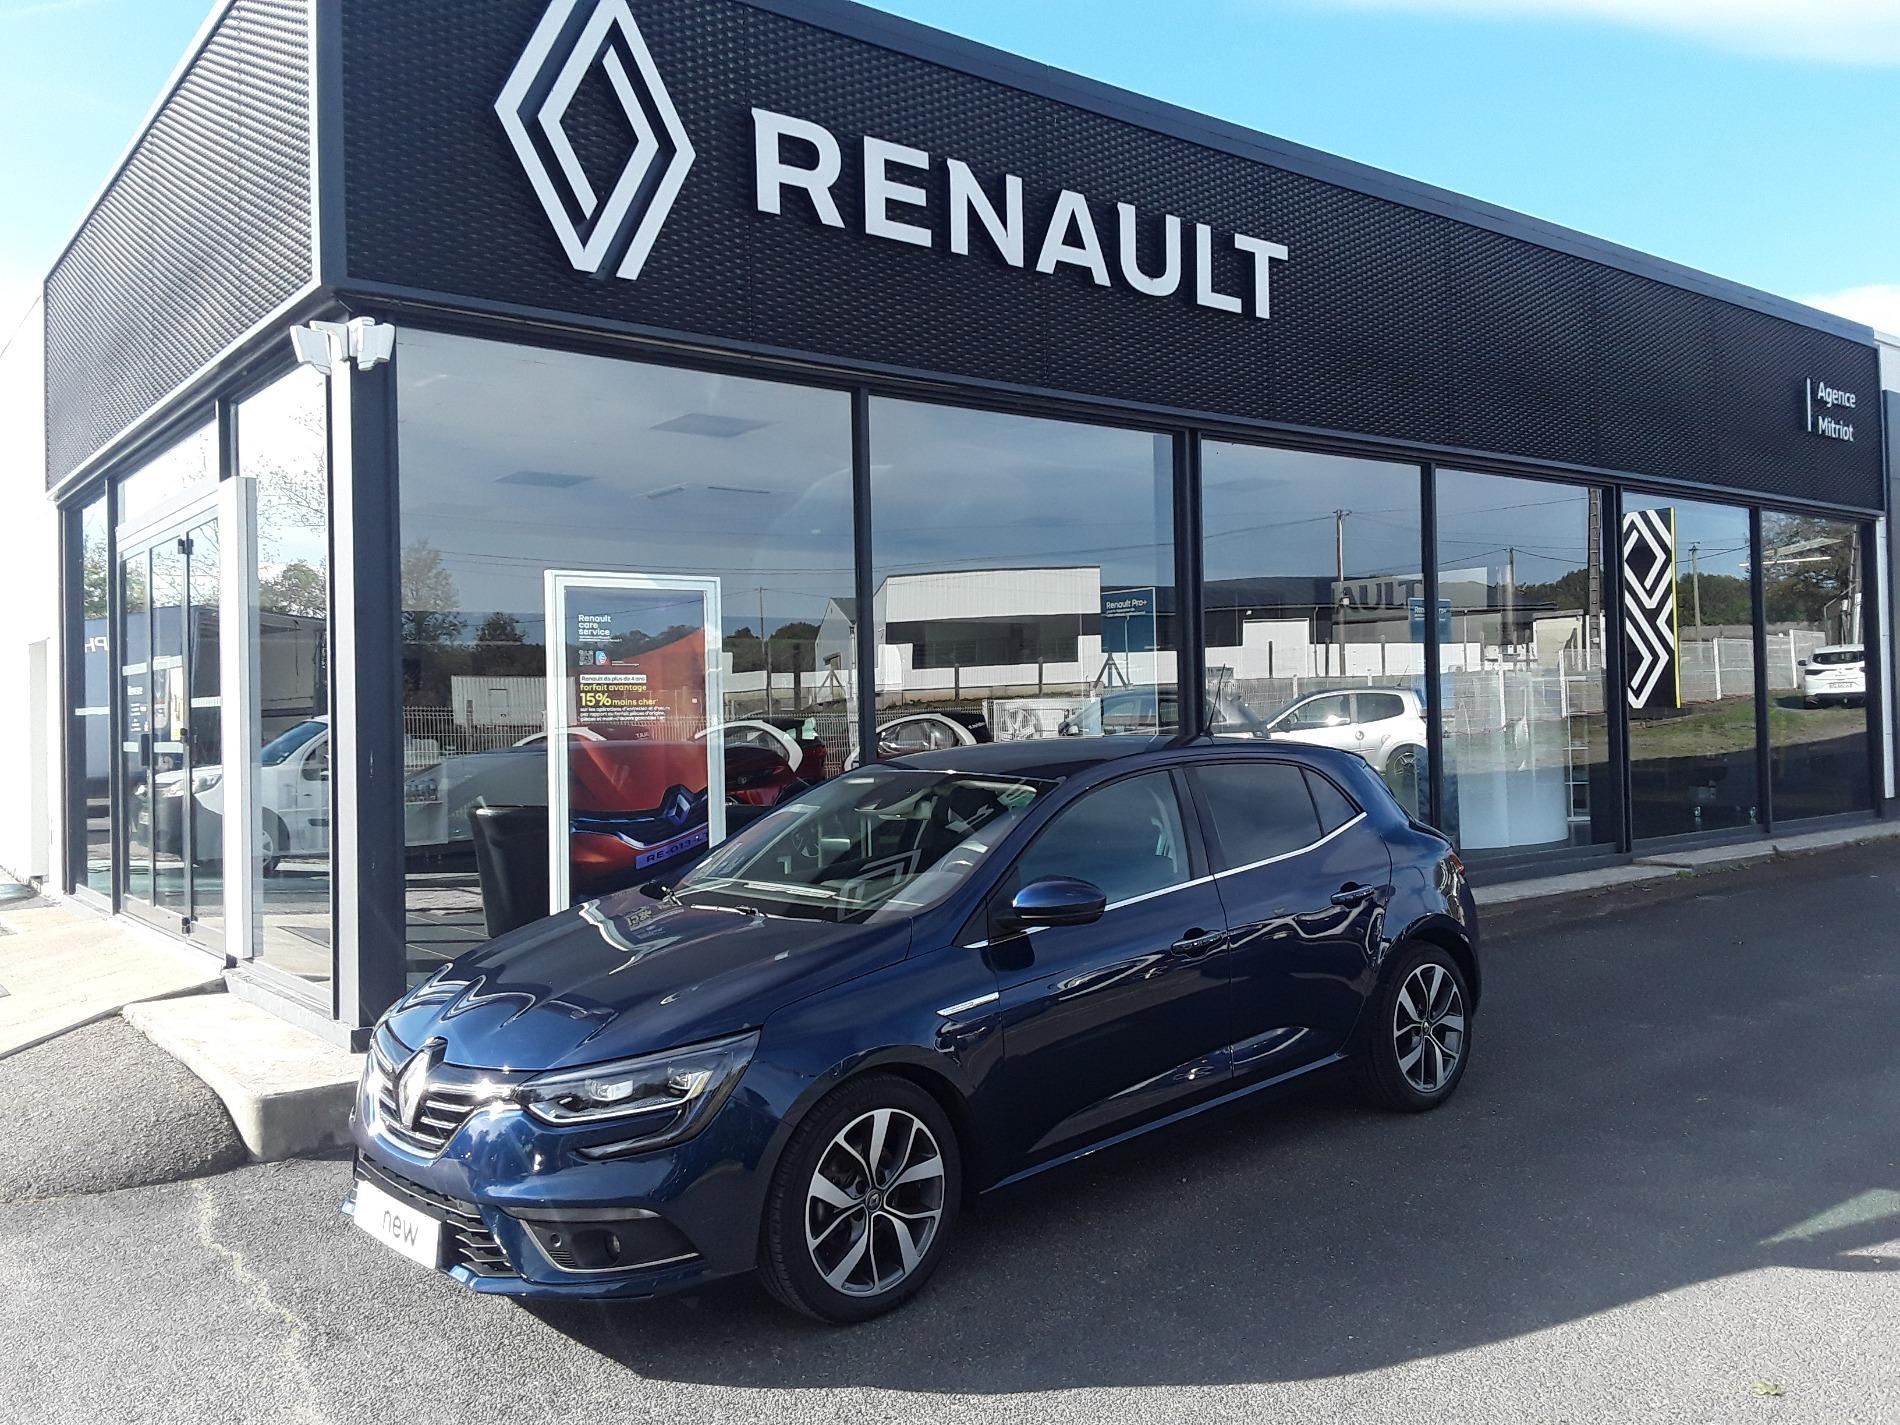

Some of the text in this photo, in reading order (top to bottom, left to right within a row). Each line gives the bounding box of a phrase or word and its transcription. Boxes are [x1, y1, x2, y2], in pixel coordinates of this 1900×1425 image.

[751, 107, 1289, 320] RENAULT
[1817, 381, 1856, 408] Agence
[1817, 415, 1854, 442] Mitriot
[1106, 598, 1147, 609] Renault Pro+
[578, 614, 611, 622] Renault
[580, 692, 612, 706] 15%
[382, 1209, 419, 1247] new
